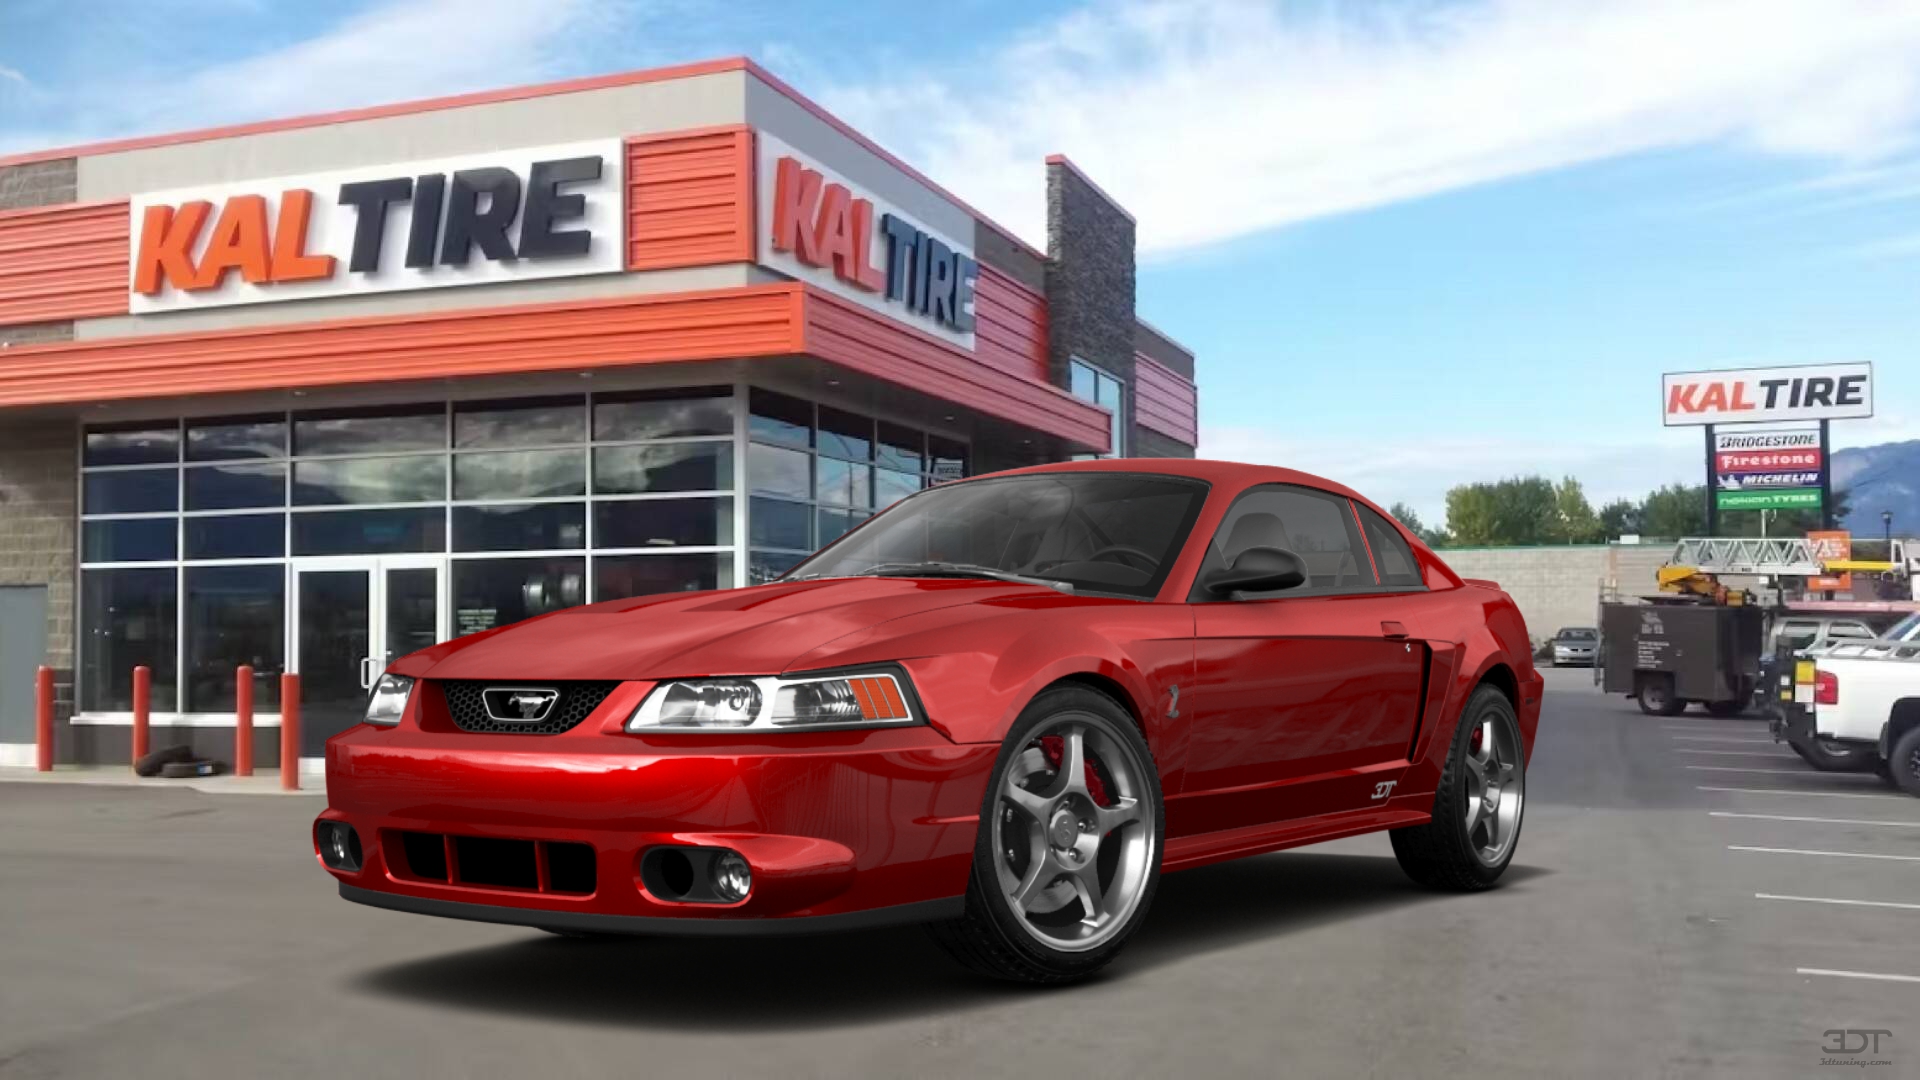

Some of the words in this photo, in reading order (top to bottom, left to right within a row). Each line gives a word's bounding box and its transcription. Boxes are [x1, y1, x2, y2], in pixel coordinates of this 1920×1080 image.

[134, 189, 337, 294] KAL
[338, 156, 602, 272] TIRE
[772, 156, 886, 293] KAL
[882, 213, 978, 332] TIRE
[1668, 382, 1755, 414] KAL
[1759, 375, 1867, 409] TIRE
[1720, 434, 1816, 448] BRIDGESTONE
[1721, 453, 1816, 469] Firestone
[1742, 473, 1818, 484] MICHELIN
